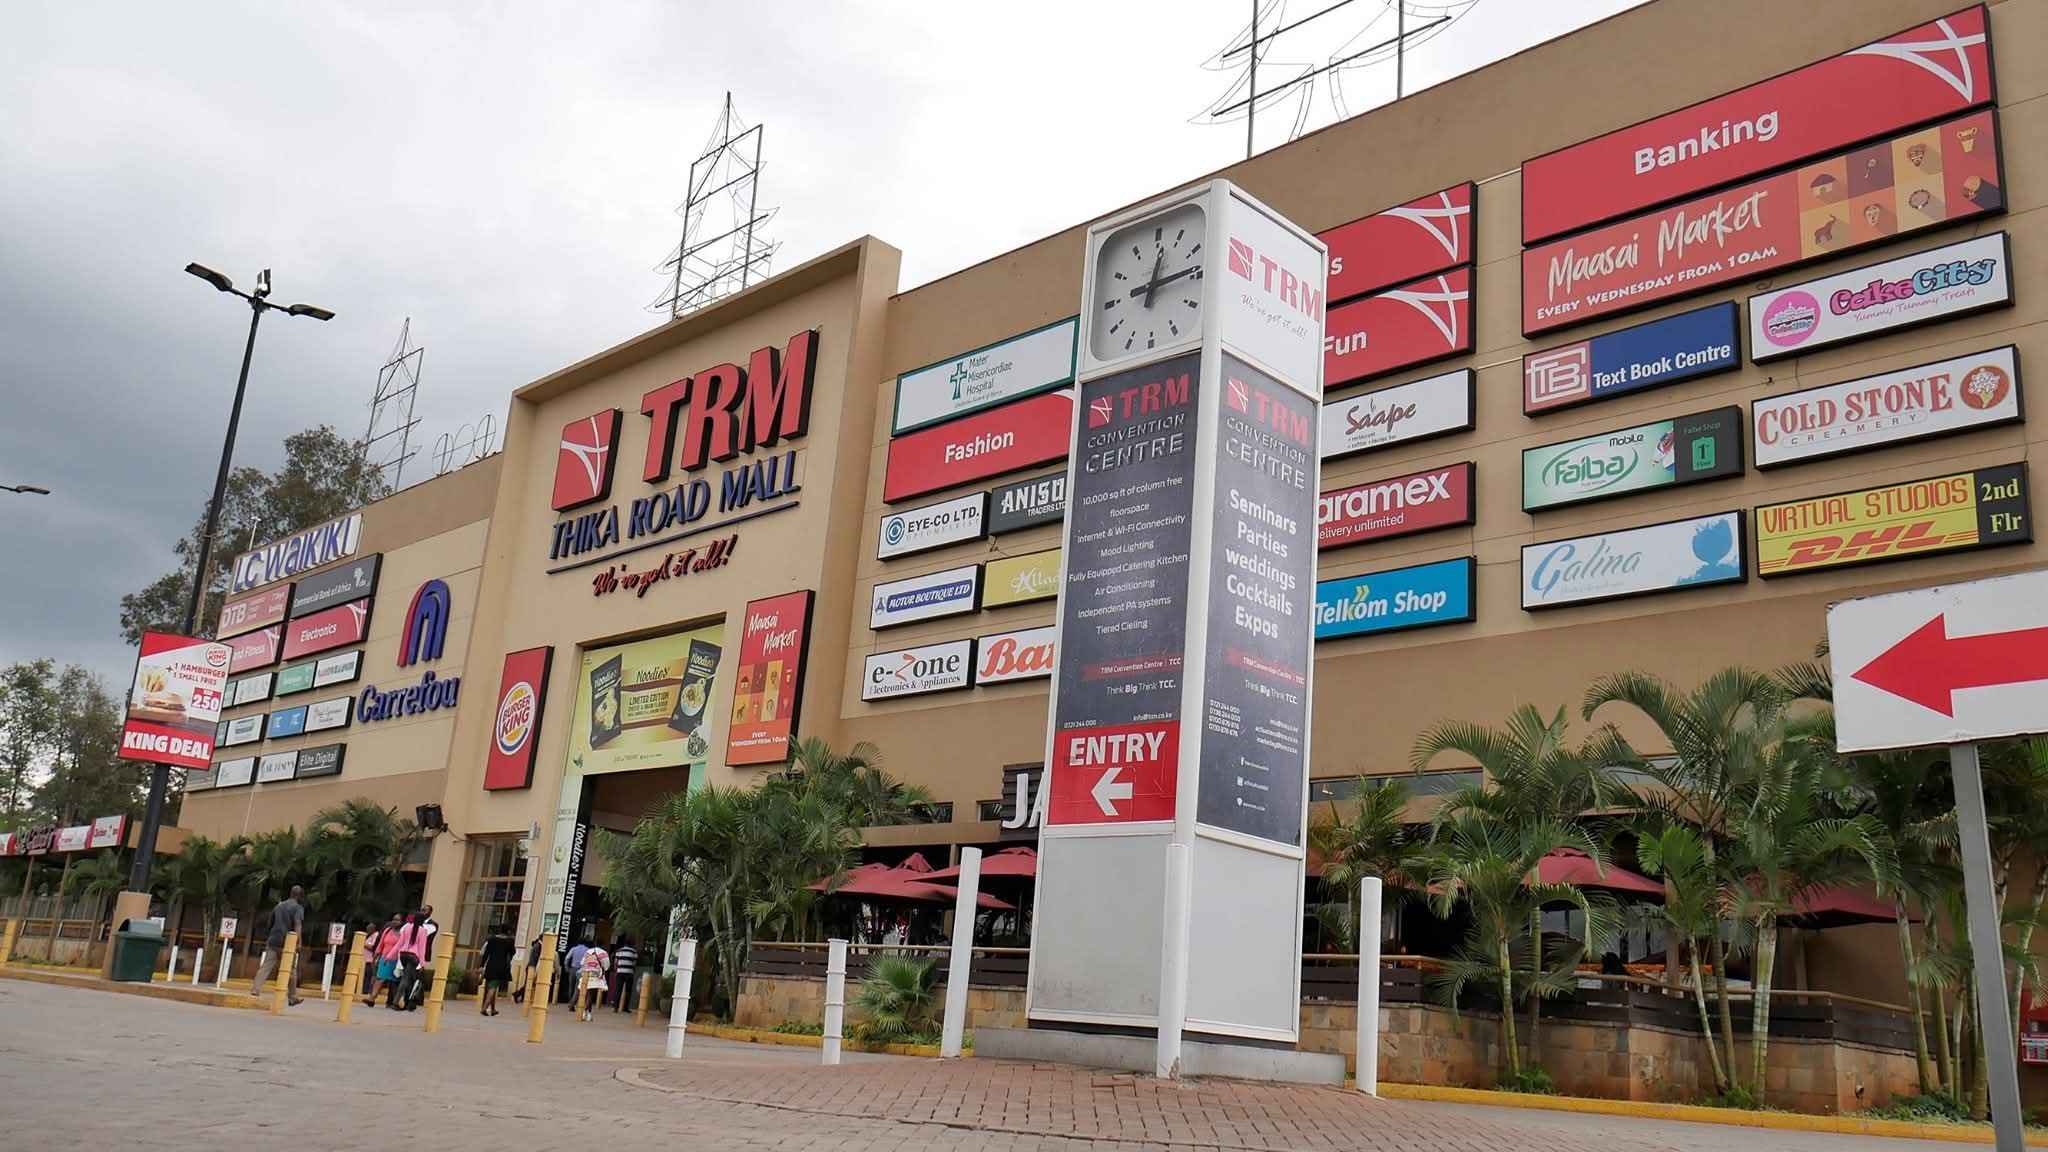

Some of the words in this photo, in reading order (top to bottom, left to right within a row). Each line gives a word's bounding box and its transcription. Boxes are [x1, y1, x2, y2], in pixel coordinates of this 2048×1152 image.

[1634, 111, 1779, 175] Banking
[1548, 233, 1640, 302] Maasai
[1657, 190, 1768, 268] Market
[1260, 255, 1321, 323] TRM
[1536, 300, 1580, 320] EVERY
[1586, 274, 1675, 305] WEDNESDAY
[1677, 262, 1722, 282] FROM
[1727, 247, 1777, 268] 10AM
[969, 355, 991, 369] Mater
[1593, 371, 1626, 389] Text
[1630, 359, 1673, 380] Book
[1675, 344, 1731, 369] Centre
[966, 378, 993, 396] Hospital
[1120, 373, 1191, 418] TRM
[640, 329, 819, 484] TRM
[1253, 389, 1310, 448] TRM
[1758, 399, 1837, 446] COLD
[1844, 373, 1953, 422] STONE
[1087, 413, 1185, 448] CONVENTION
[1226, 416, 1307, 465] CONVENTION
[1791, 414, 1917, 446] CREAMERY
[944, 431, 1014, 464] Fashion
[1086, 433, 1184, 473] CENTRE
[1225, 438, 1305, 489] CENTRE
[1127, 485, 1136, 495] of
[1136, 480, 1166, 493] column
[1167, 476, 1183, 485] free
[1554, 455, 1625, 487] Faiba
[548, 505, 620, 560] THIKA
[627, 479, 711, 539] ROAD
[718, 450, 802, 513] MALL
[1317, 471, 1450, 526] aramex
[1763, 497, 1856, 534] VIRTUAL
[1865, 477, 1968, 519] STUDIOS
[1981, 478, 2019, 502] 2nd
[908, 513, 950, 533] EYE-CO
[953, 506, 980, 525] LTD.
[1110, 503, 1150, 518] floorspace
[1230, 488, 1297, 536] Seminars
[1319, 525, 1353, 539] elivery
[1354, 511, 1405, 532] unlimited
[1990, 512, 2022, 533] Flr
[1078, 530, 1105, 543] Internet
[1136, 514, 1186, 531] Connectivity
[1237, 520, 1288, 558] Parties
[1785, 520, 1946, 567] DHL
[1100, 545, 1122, 557] Mood
[1123, 540, 1154, 553] Lighting
[233, 551, 265, 594] LC
[1068, 571, 1086, 583] Fully
[1122, 559, 1155, 572] Catering
[1157, 553, 1188, 565] Kitchen
[1225, 548, 1296, 591] weddings
[889, 594, 915, 609] MOTOR
[915, 587, 954, 605] BOUTIQUE
[954, 583, 970, 596] LTD
[1095, 587, 1105, 597] Air
[1105, 579, 1155, 595] Conditioning
[1227, 574, 1294, 616] Cocktails
[223, 603, 247, 628] DTB
[1078, 603, 1125, 618] Independent
[1125, 600, 1137, 610] PA
[1138, 596, 1172, 609] systems
[1235, 605, 1279, 639] Expos
[1315, 597, 1388, 625] Telkom
[1393, 589, 1446, 615] Shop
[300, 623, 337, 643] Electronics
[748, 610, 780, 639] Maasai
[763, 629, 799, 657] Market
[181, 663, 226, 678] HAMBURGER
[1168, 657, 1181, 665] TCC
[179, 673, 199, 683] SMALL
[869, 680, 910, 696] Electronics
[911, 679, 917, 690] &
[918, 675, 961, 692] Appliances
[1125, 683, 1138, 695] Big
[192, 694, 219, 712] 250
[357, 670, 462, 723] Carrefou
[502, 695, 531, 723] BURGER
[501, 707, 531, 738] KING
[123, 731, 168, 753] KING
[168, 738, 211, 761] DEAL
[314, 751, 337, 767] Digital
[1069, 731, 1166, 766] ENTRY
[563, 873, 578, 913] LIMITED
[558, 914, 572, 953] EDITION
